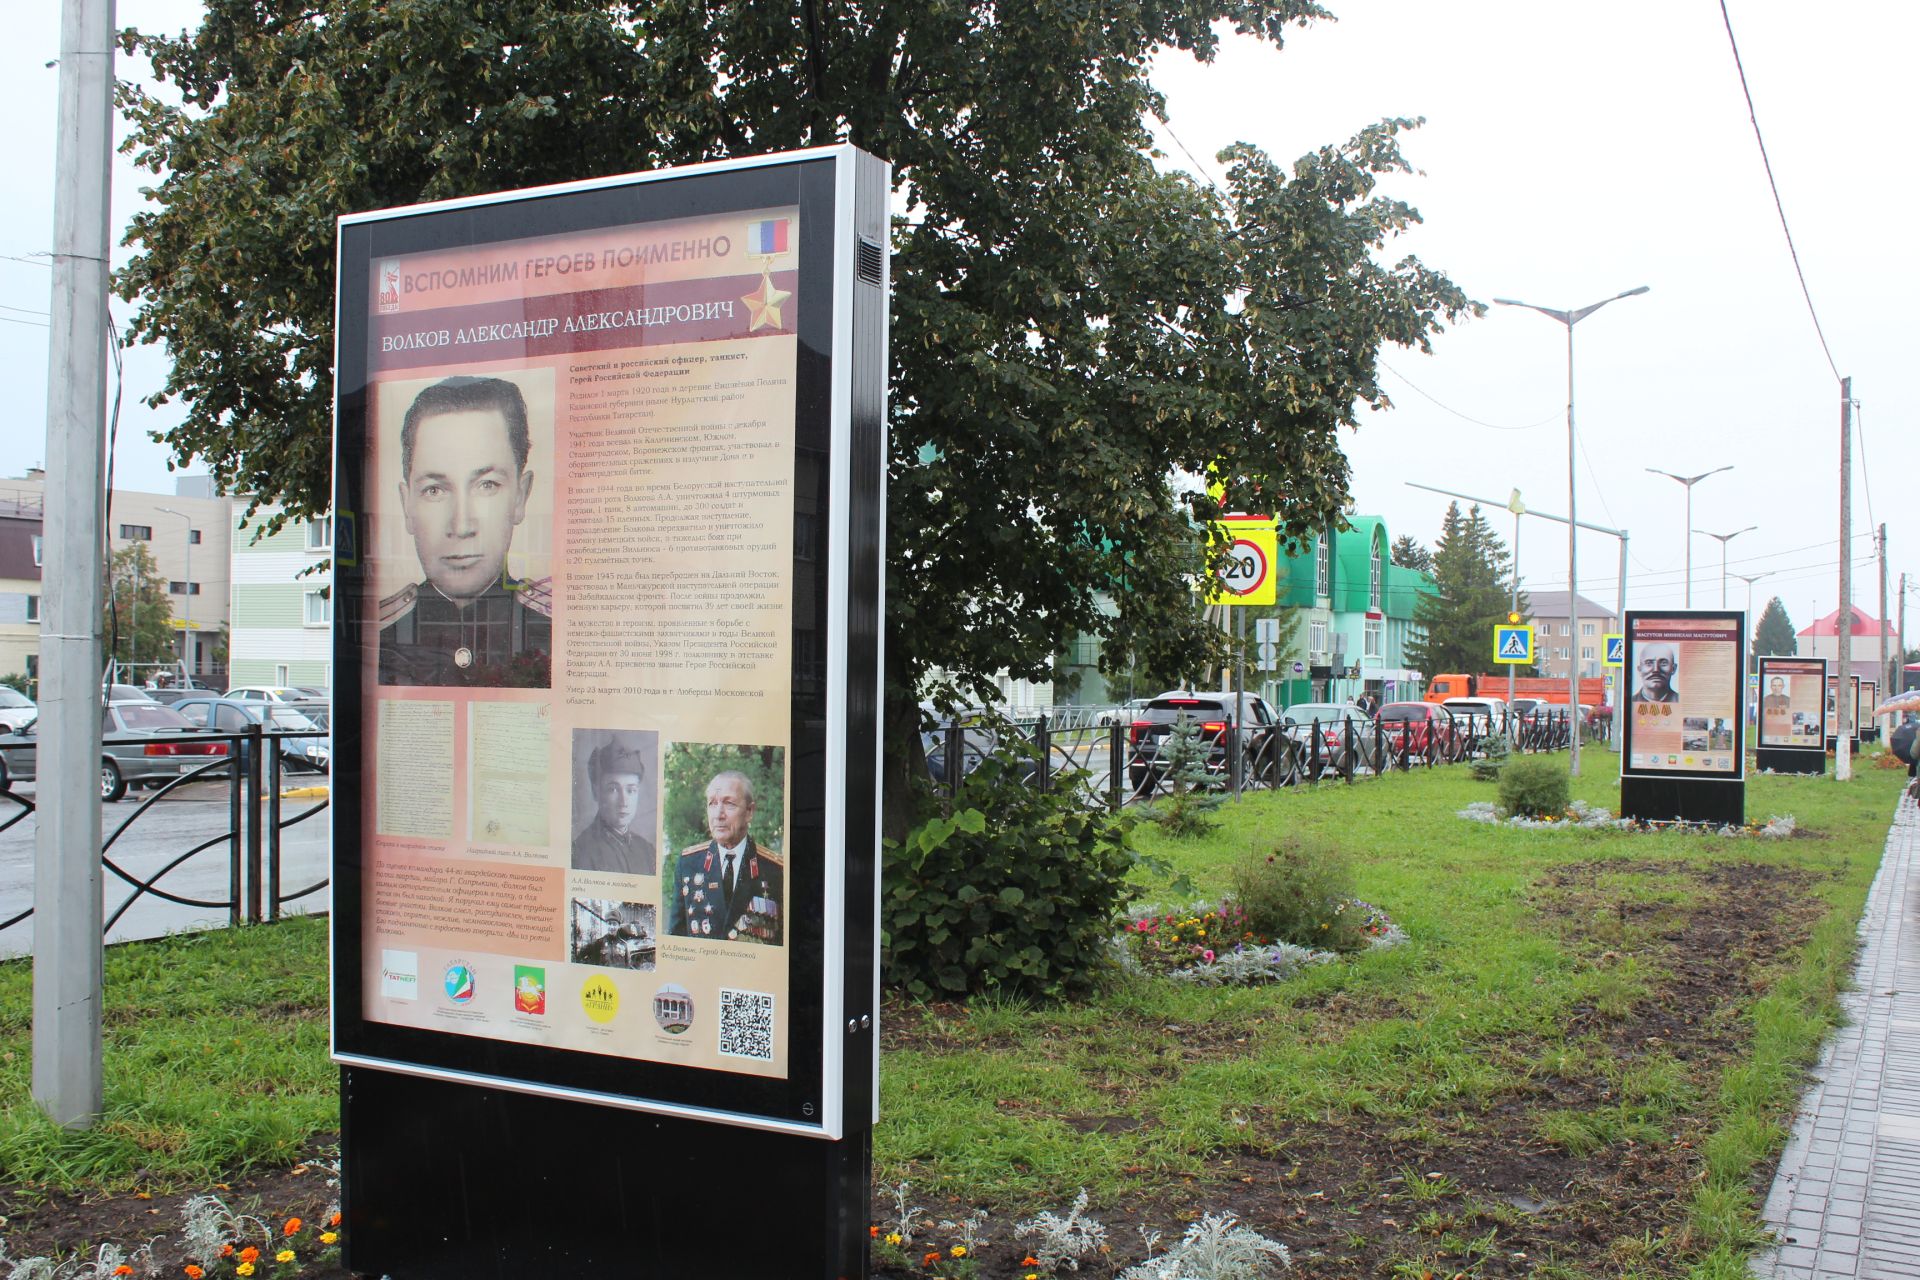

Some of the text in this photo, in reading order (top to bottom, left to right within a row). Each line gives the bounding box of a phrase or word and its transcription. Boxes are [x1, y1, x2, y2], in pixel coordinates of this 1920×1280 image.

[404, 233, 731, 293] ВСПОМНИМ ГЕРОЕВ ПОИМЕННО
[381, 298, 734, 352] ВОЛКОВ АЛЕКСАНДР АЛЕКСАНДРОВИЧ
[569, 362, 611, 373] Советский
[619, 357, 669, 370] российский
[671, 354, 707, 366] офицер,
[709, 352, 748, 363] танкист,
[569, 366, 690, 385] Герой Российской Федерации
